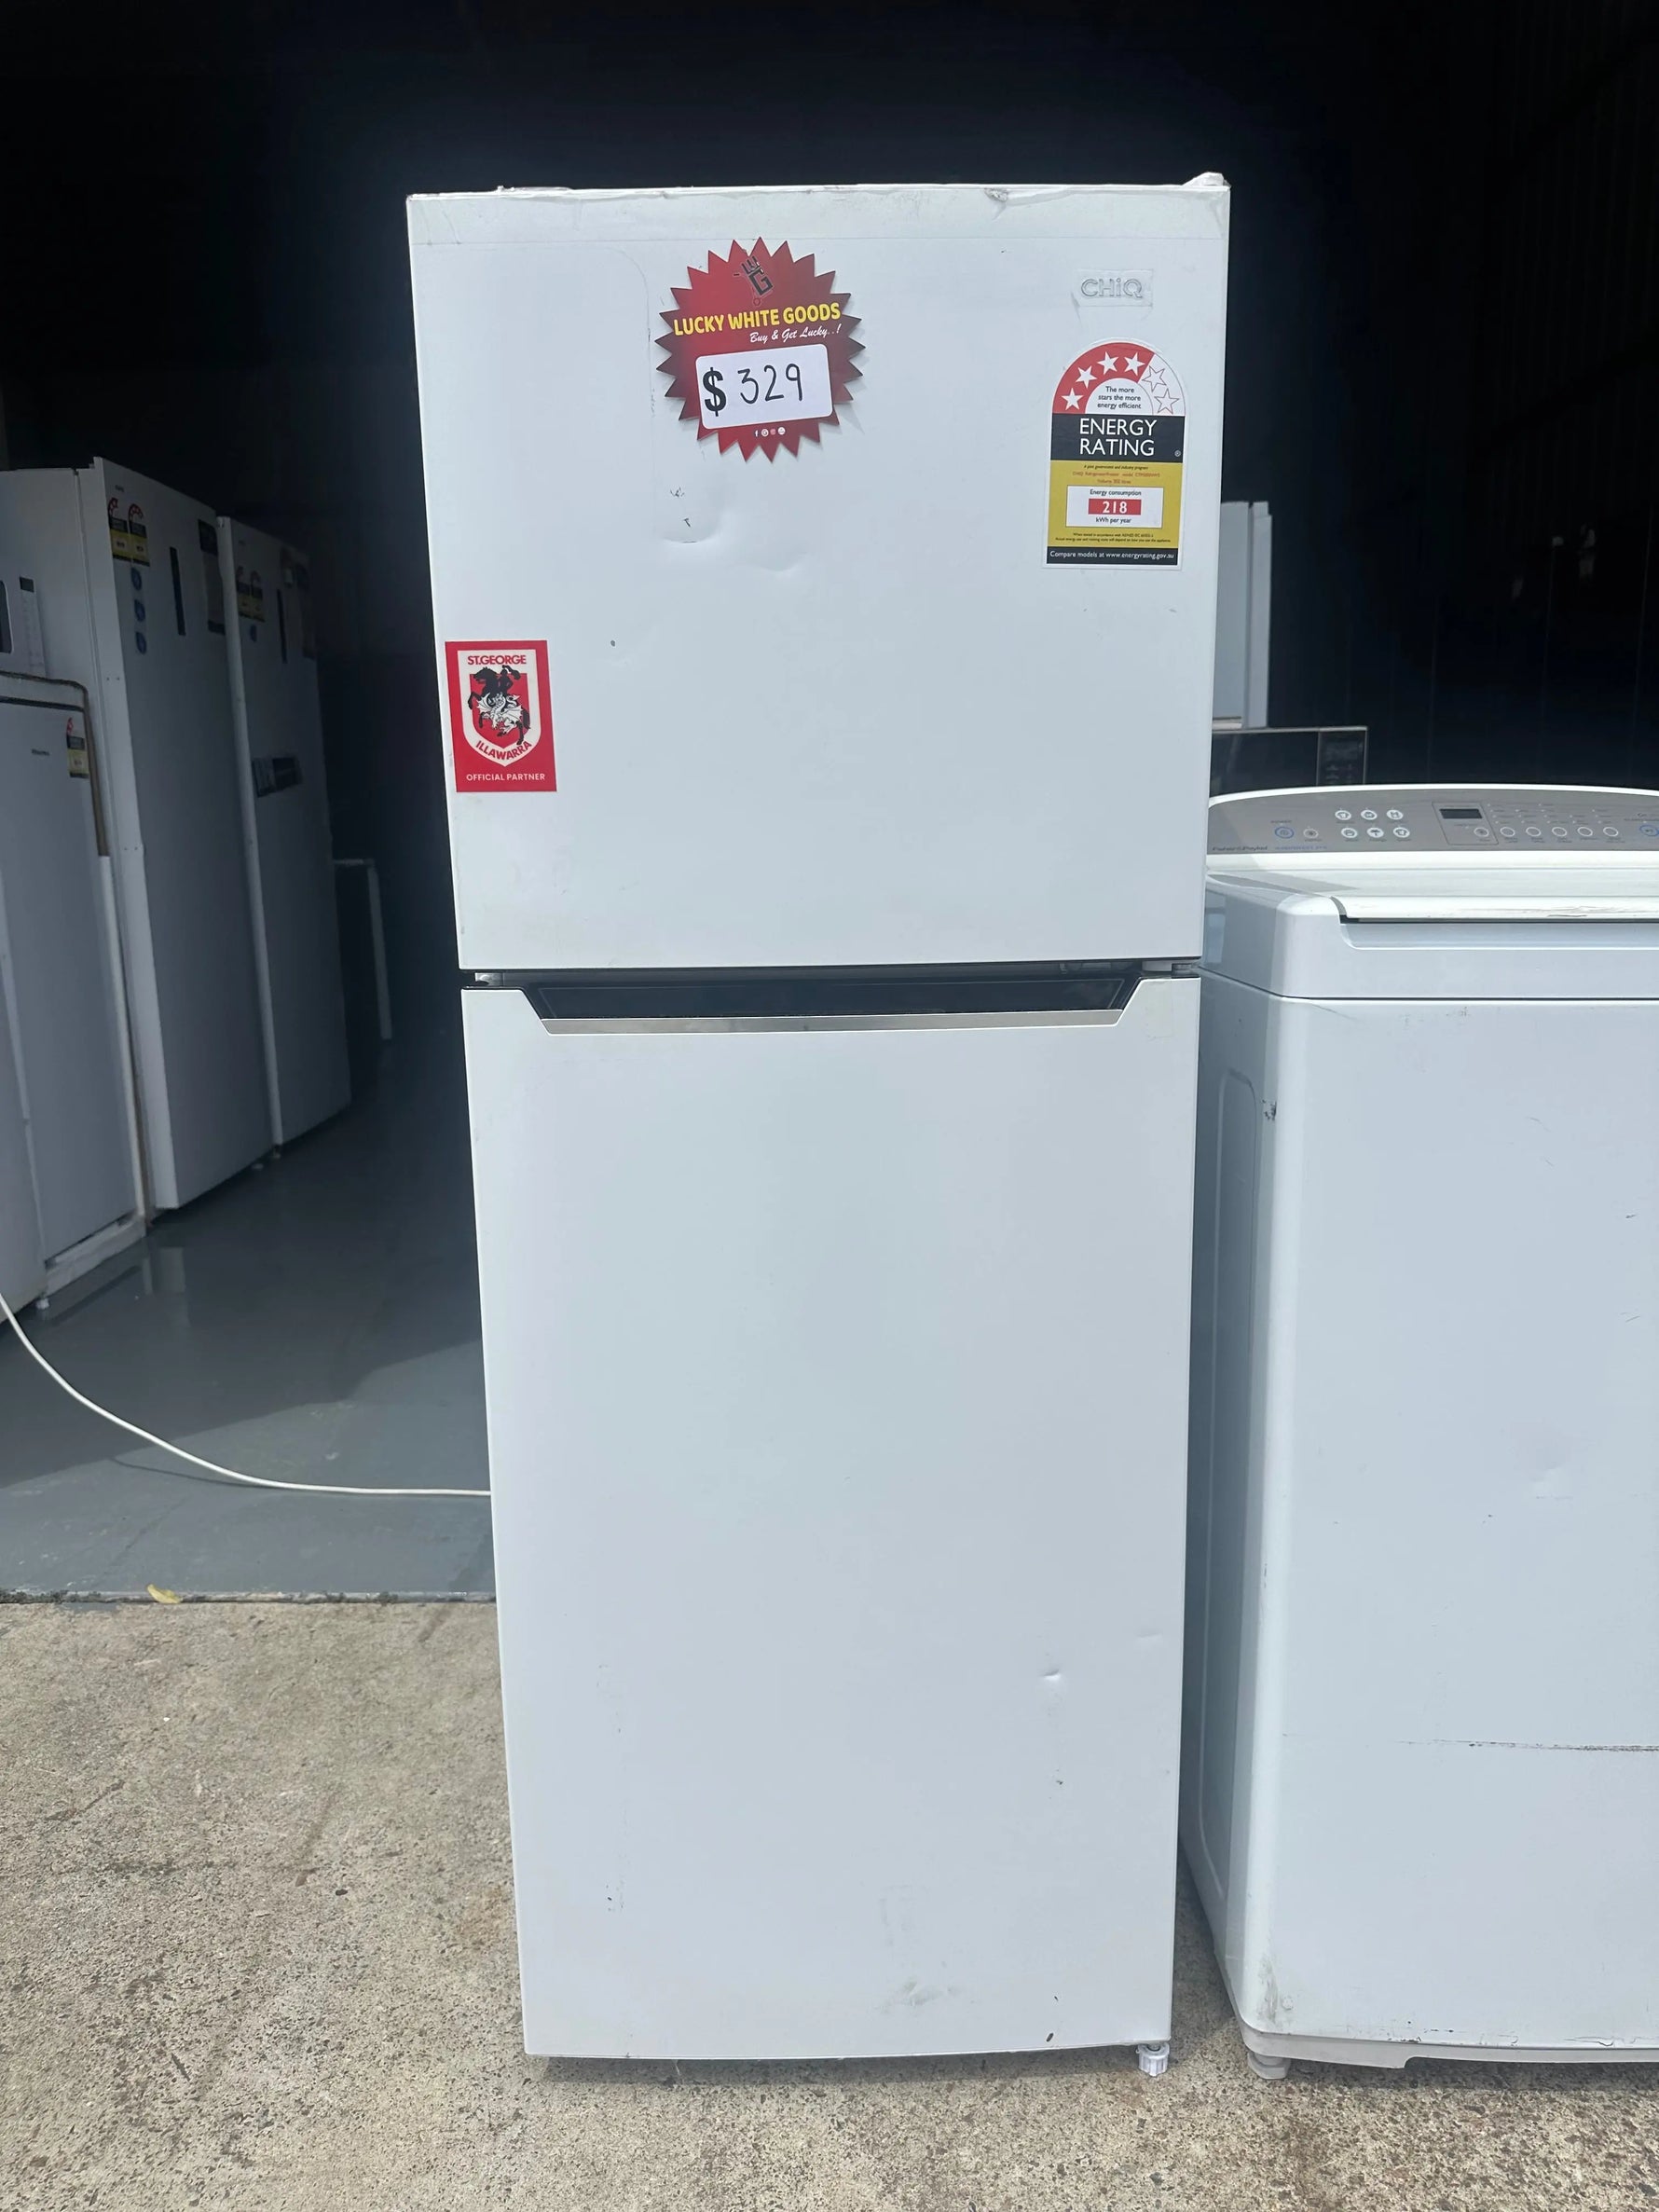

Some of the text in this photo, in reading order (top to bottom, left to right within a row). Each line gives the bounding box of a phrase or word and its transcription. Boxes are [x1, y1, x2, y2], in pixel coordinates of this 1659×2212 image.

[674, 302, 841, 336] LUCKY WHITE GOODS
[749, 332, 768, 344] Buy
[772, 329, 779, 340] &
[782, 328, 798, 342] Get
[702, 364, 802, 417] $ 329
[1079, 418, 1158, 436] ENERGY
[1079, 438, 1155, 457] RATING
[1103, 501, 1128, 514] 218
[1049, 550, 1076, 559] Compare
[1105, 552, 1174, 560] www.energyrating.gov.au
[467, 654, 527, 666] ST.GEORGE
[475, 740, 532, 761] ILLAWARRA
